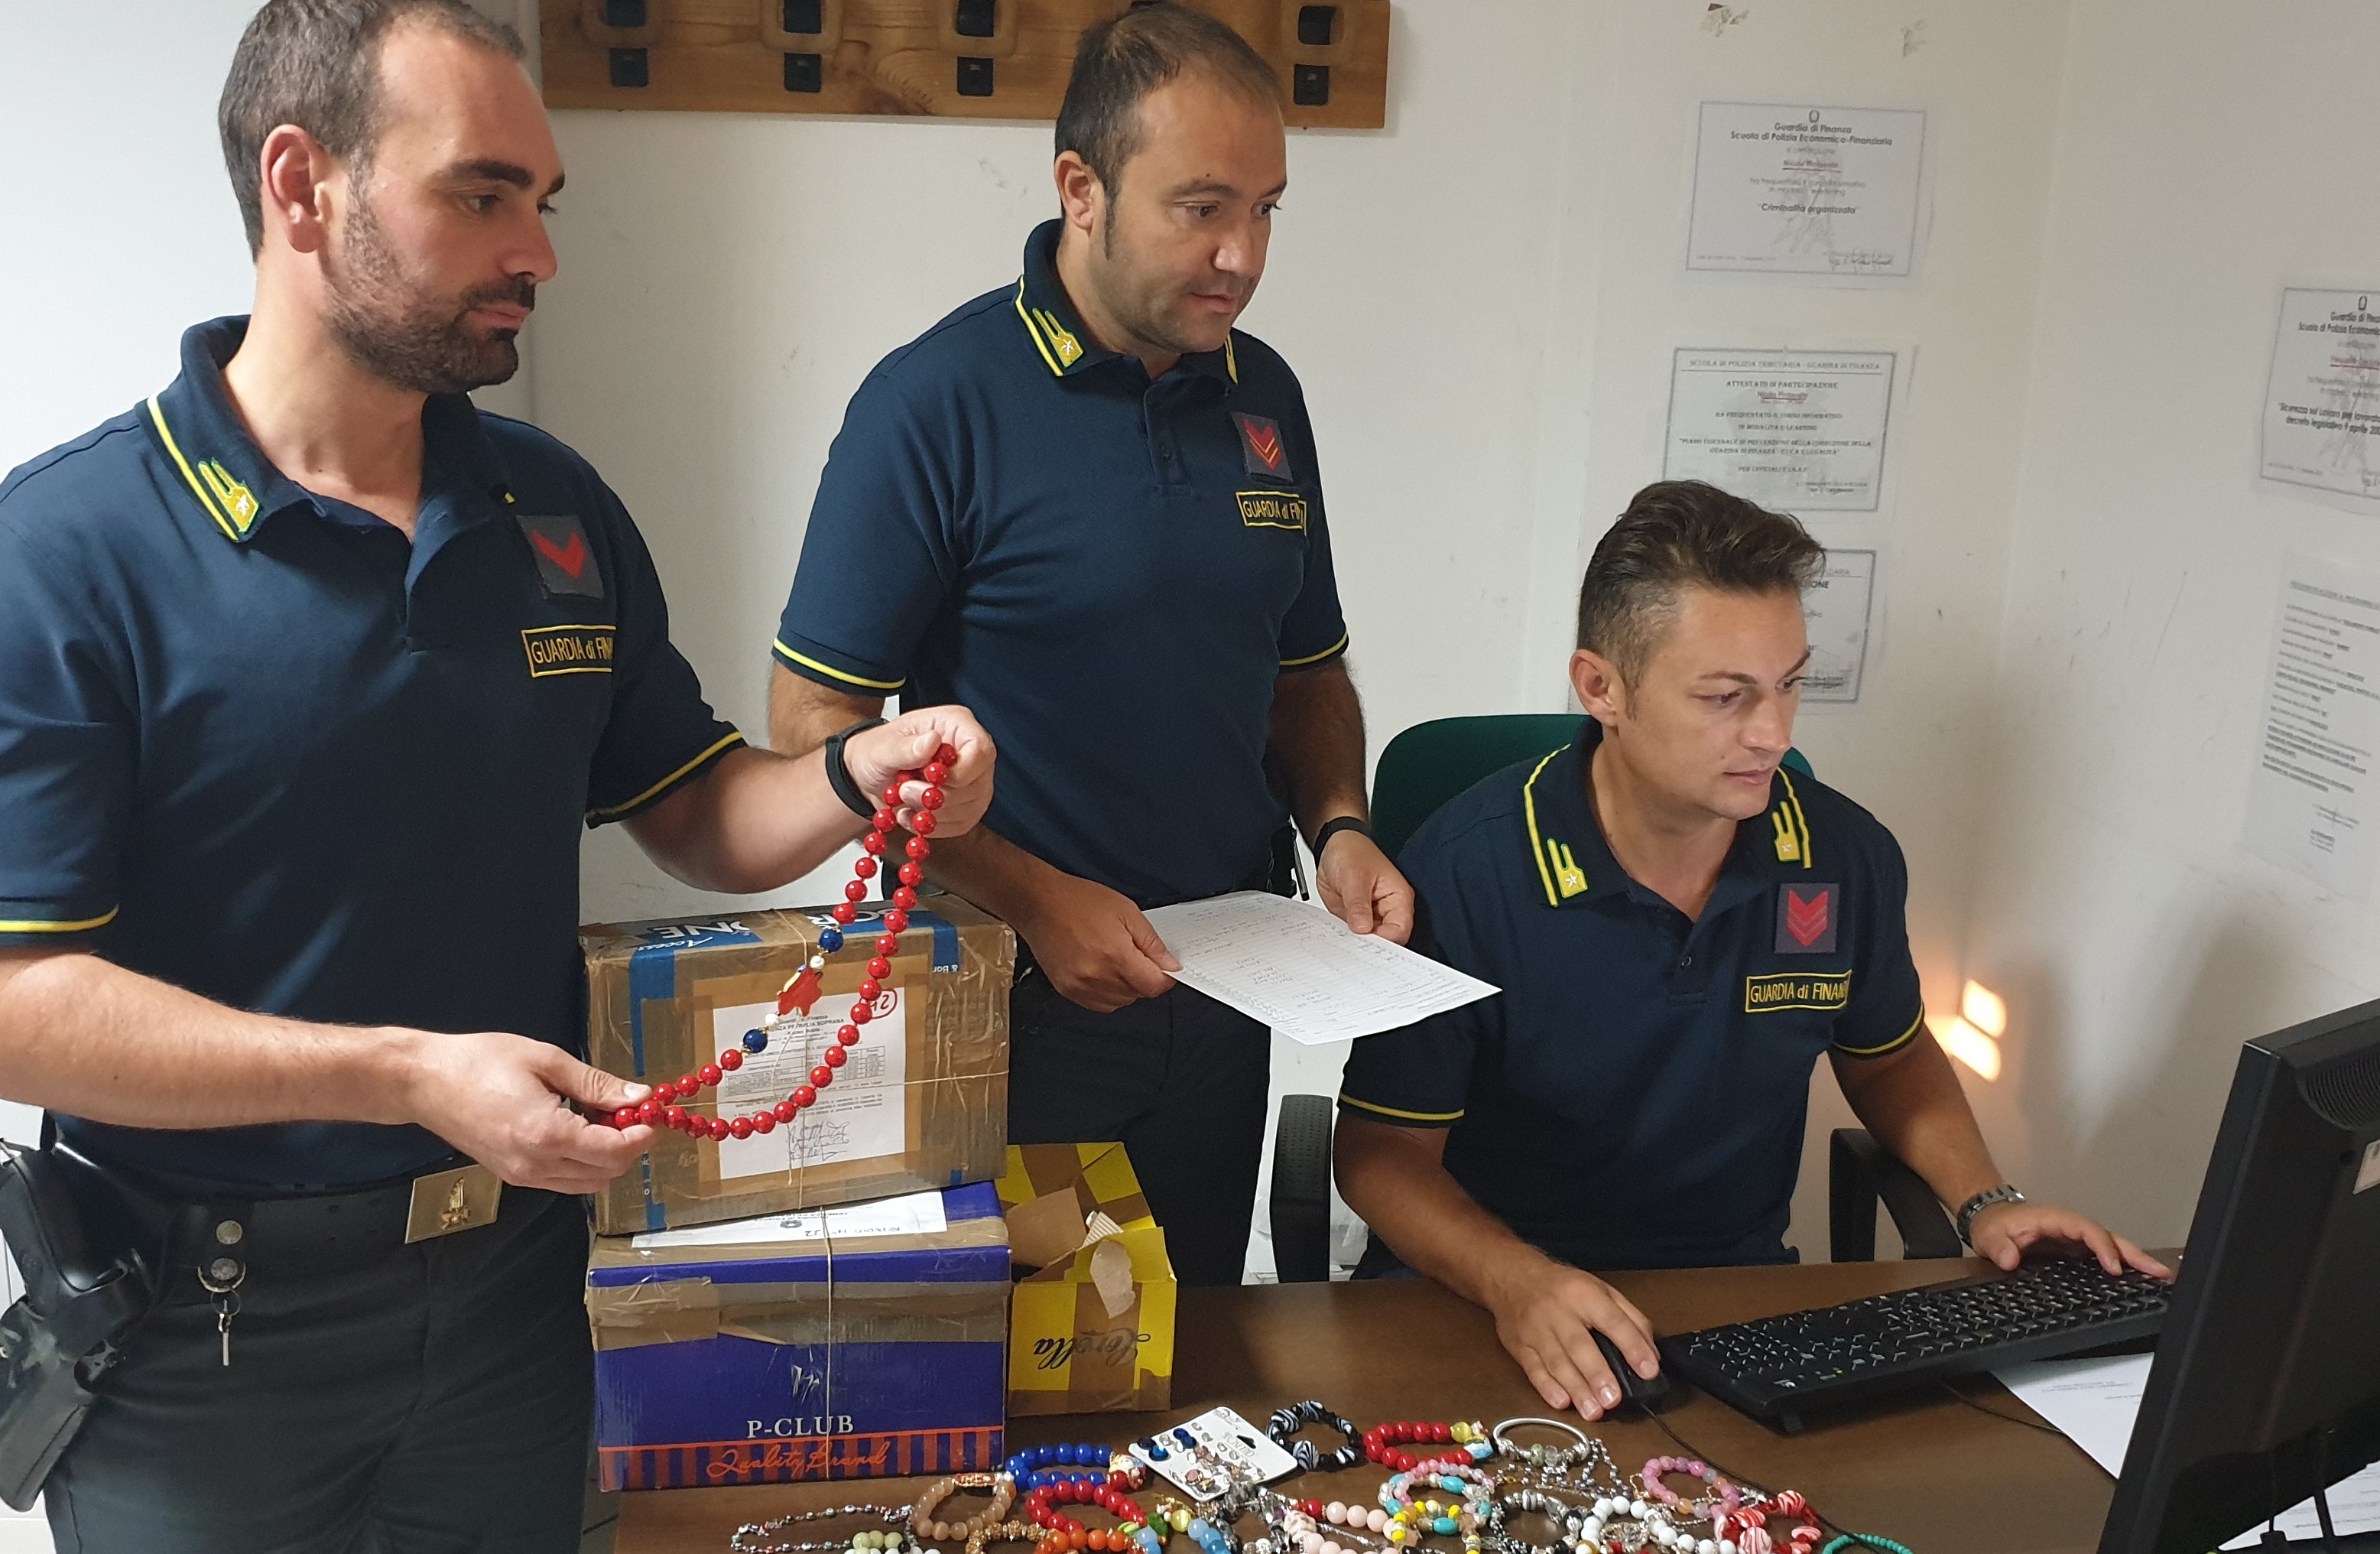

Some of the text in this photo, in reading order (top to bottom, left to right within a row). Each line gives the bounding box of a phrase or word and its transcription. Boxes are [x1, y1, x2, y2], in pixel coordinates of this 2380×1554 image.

[1731, 131, 1759, 140] Scuola
[1761, 132, 1769, 141] di
[1771, 133, 1797, 142] Polizia
[1774, 122, 1852, 134] Guardia di Finanza
[1243, 500, 1281, 518] GUARDIA
[1281, 504, 1289, 519] di
[531, 636, 585, 664] GUARDIA
[585, 640, 595, 658] di
[1751, 982, 1794, 1003] GUARDIA
[1797, 983, 1809, 1000] di
[747, 1415, 855, 1439] P-CLUB
[706, 1440, 891, 1478] Quality Brand
